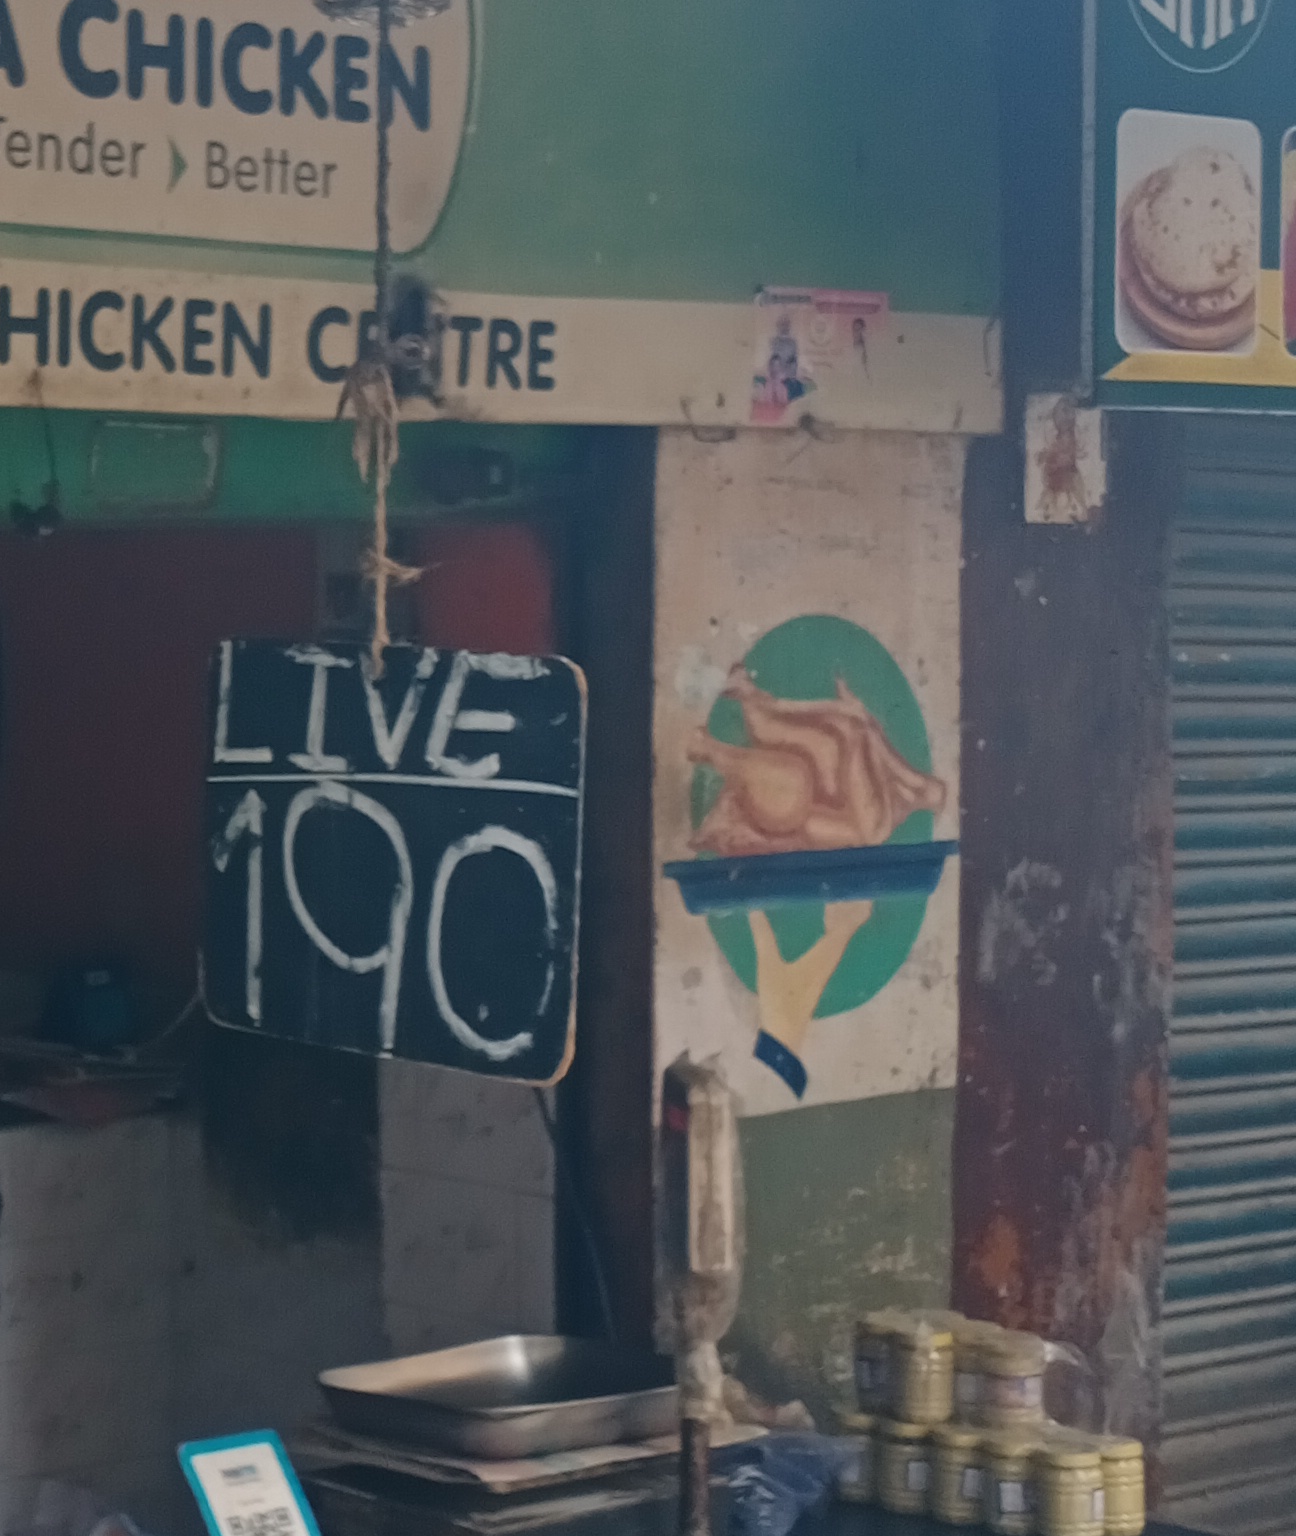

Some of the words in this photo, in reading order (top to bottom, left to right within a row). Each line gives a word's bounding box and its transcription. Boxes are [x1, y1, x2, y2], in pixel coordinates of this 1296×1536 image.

[204, 140, 338, 200] Better
[306, 305, 557, 390] CTRE
[212, 639, 551, 780] LIVE
[212, 780, 559, 1061] 190
